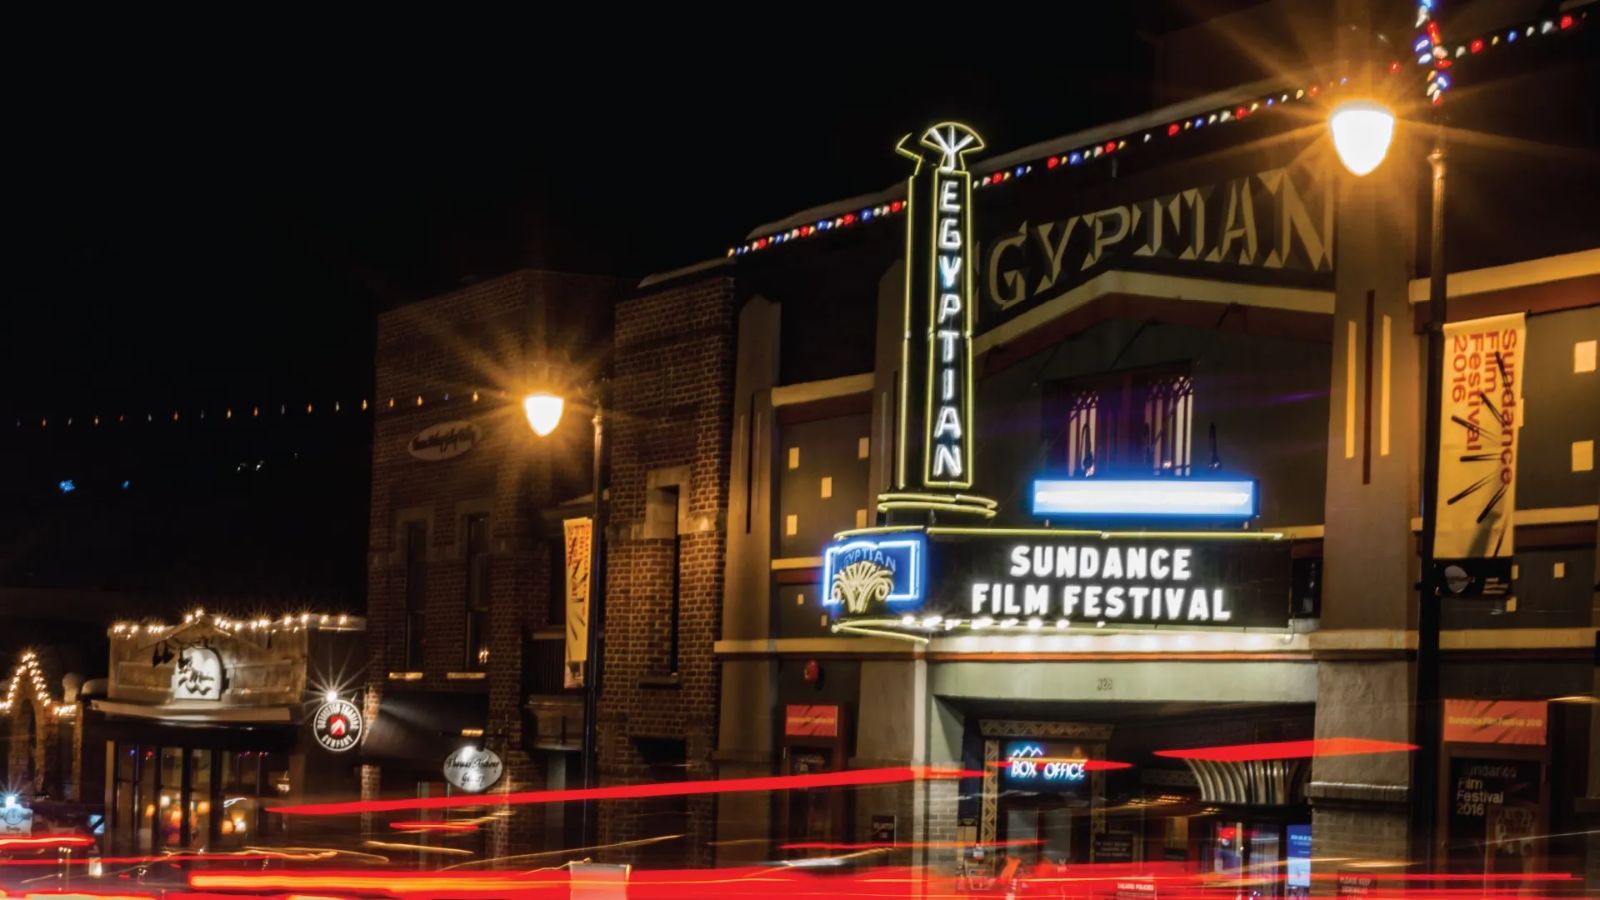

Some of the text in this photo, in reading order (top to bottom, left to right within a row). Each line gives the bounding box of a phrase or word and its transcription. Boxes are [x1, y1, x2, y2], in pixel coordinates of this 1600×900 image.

[975, 165, 1334, 320] GYPTIAN
[934, 180, 963, 478] EGYPTIAN
[1452, 335, 1468, 404] 2016
[1484, 331, 1500, 394] Film
[1466, 332, 1484, 451] Festival
[1500, 328, 1518, 486] Sundance
[1010, 546, 1192, 580] SUNDANCE
[971, 583, 1231, 621] FILM FESTIVAL
[321, 734, 353, 748] COMPANY
[1011, 760, 1085, 780] BOX OFFICE
[1458, 777, 1484, 790] Film
[1456, 789, 1505, 804] Festival
[1456, 802, 1485, 816] 2016
